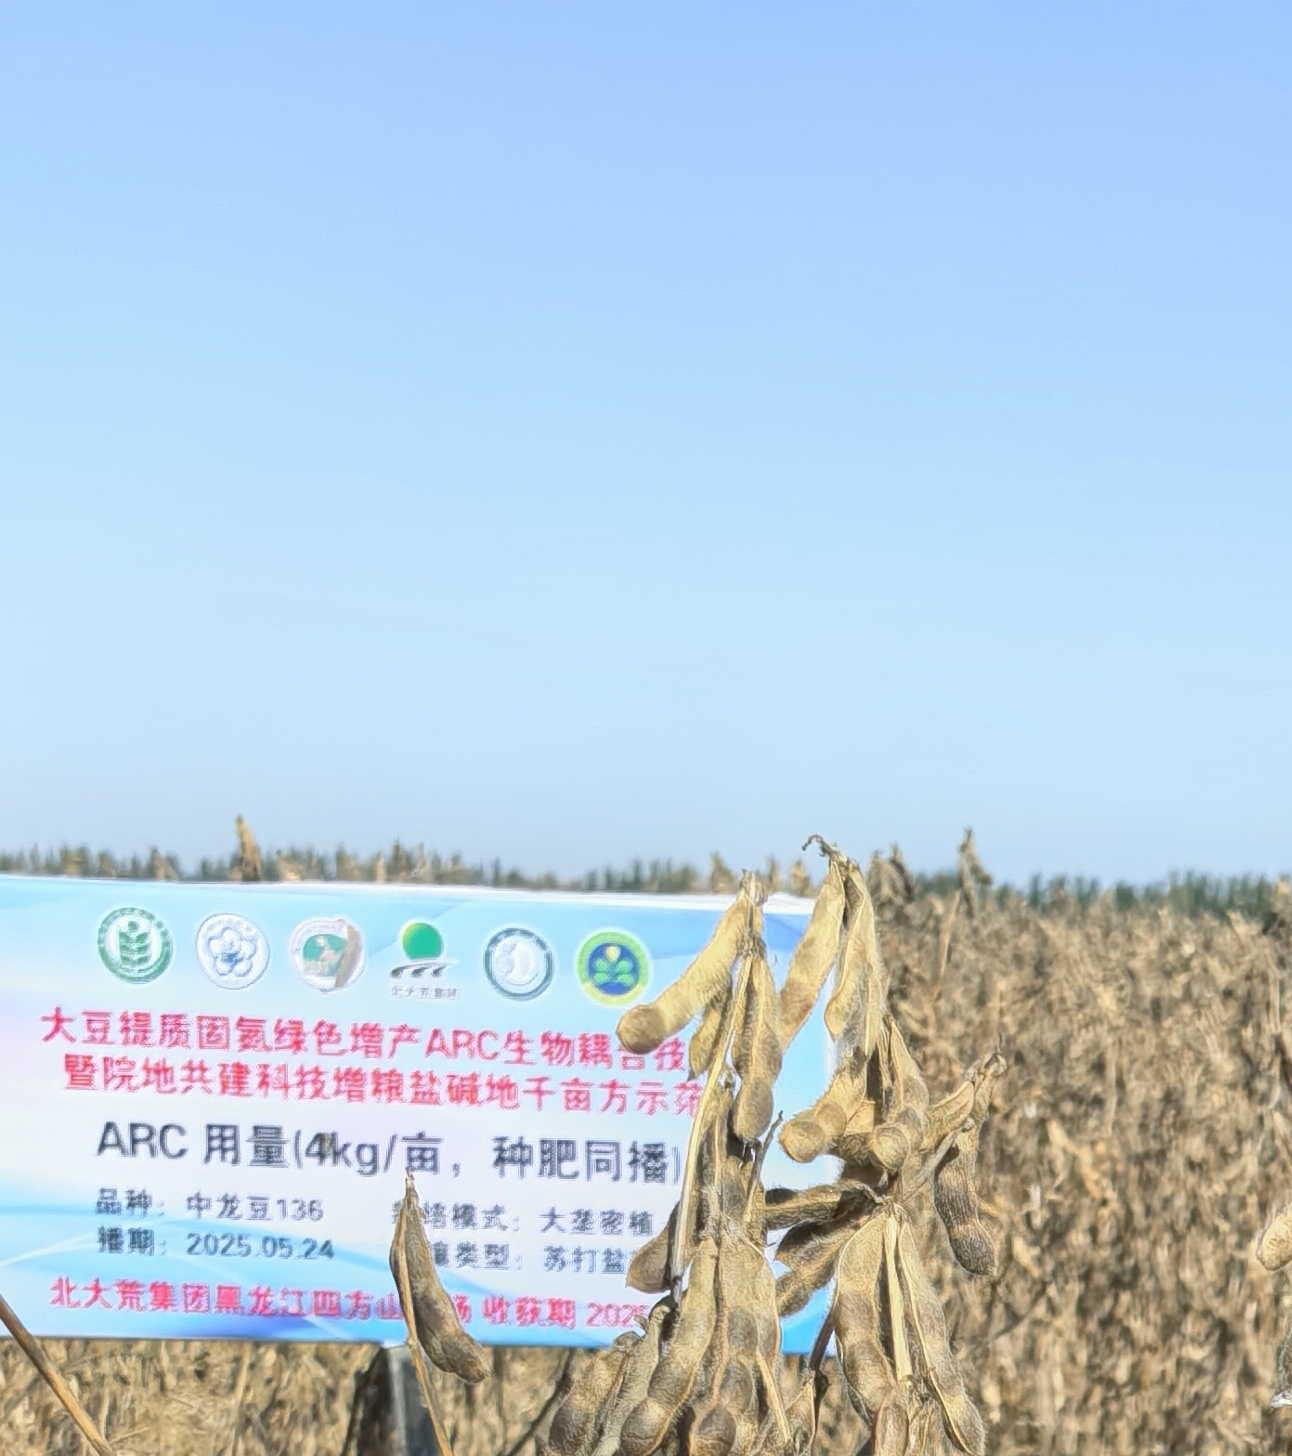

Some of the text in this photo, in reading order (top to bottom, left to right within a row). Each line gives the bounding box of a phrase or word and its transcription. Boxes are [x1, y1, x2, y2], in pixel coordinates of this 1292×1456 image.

[97, 1121, 188, 1160] ARC
[49, 1277, 472, 1325] 北大荒集团黑龙江四方山场
[482, 1295, 577, 1330] 收获期
